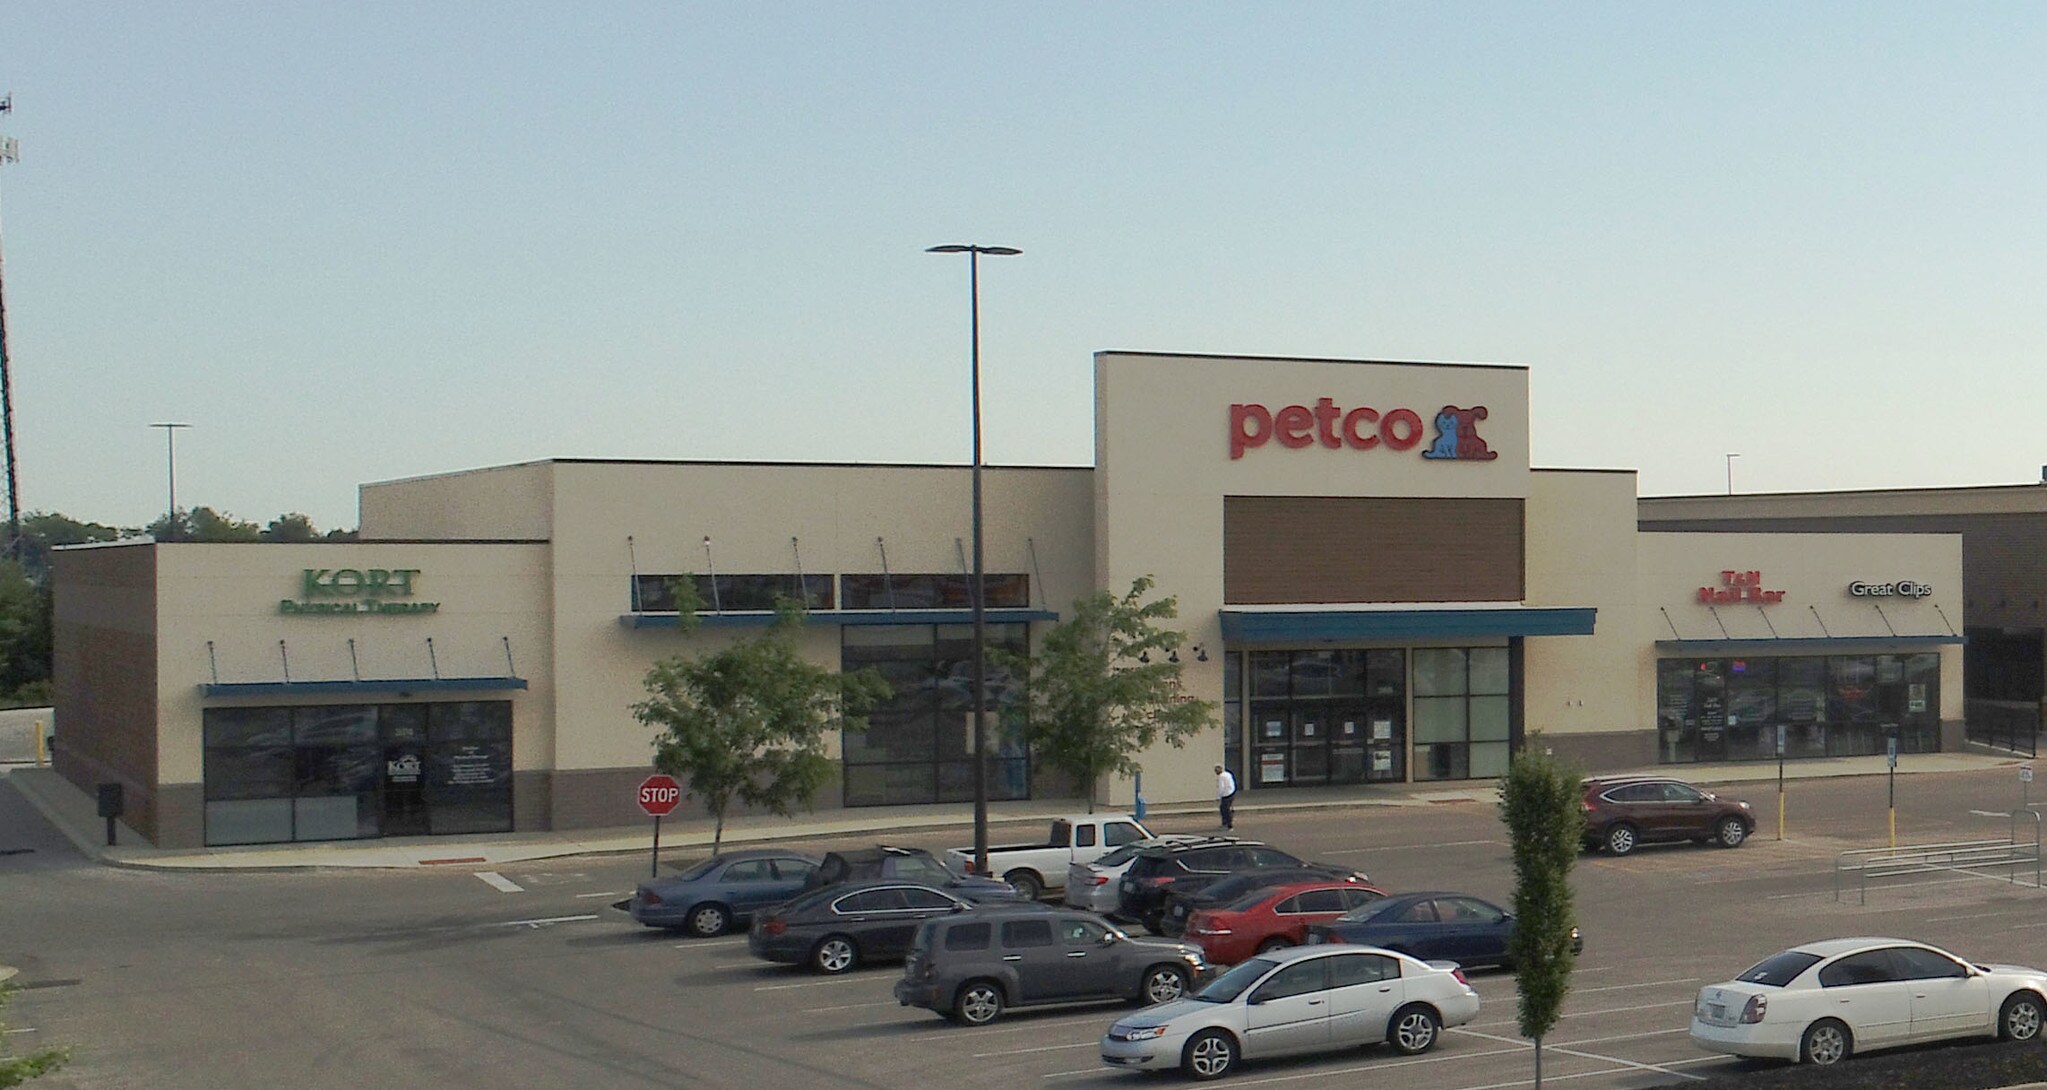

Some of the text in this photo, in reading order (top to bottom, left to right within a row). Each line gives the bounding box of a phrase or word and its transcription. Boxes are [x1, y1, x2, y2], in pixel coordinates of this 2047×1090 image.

[1230, 397, 1424, 460] petco
[303, 569, 421, 596] KORT
[1850, 581, 1932, 599] Great Clips
[641, 787, 679, 803] STOP
